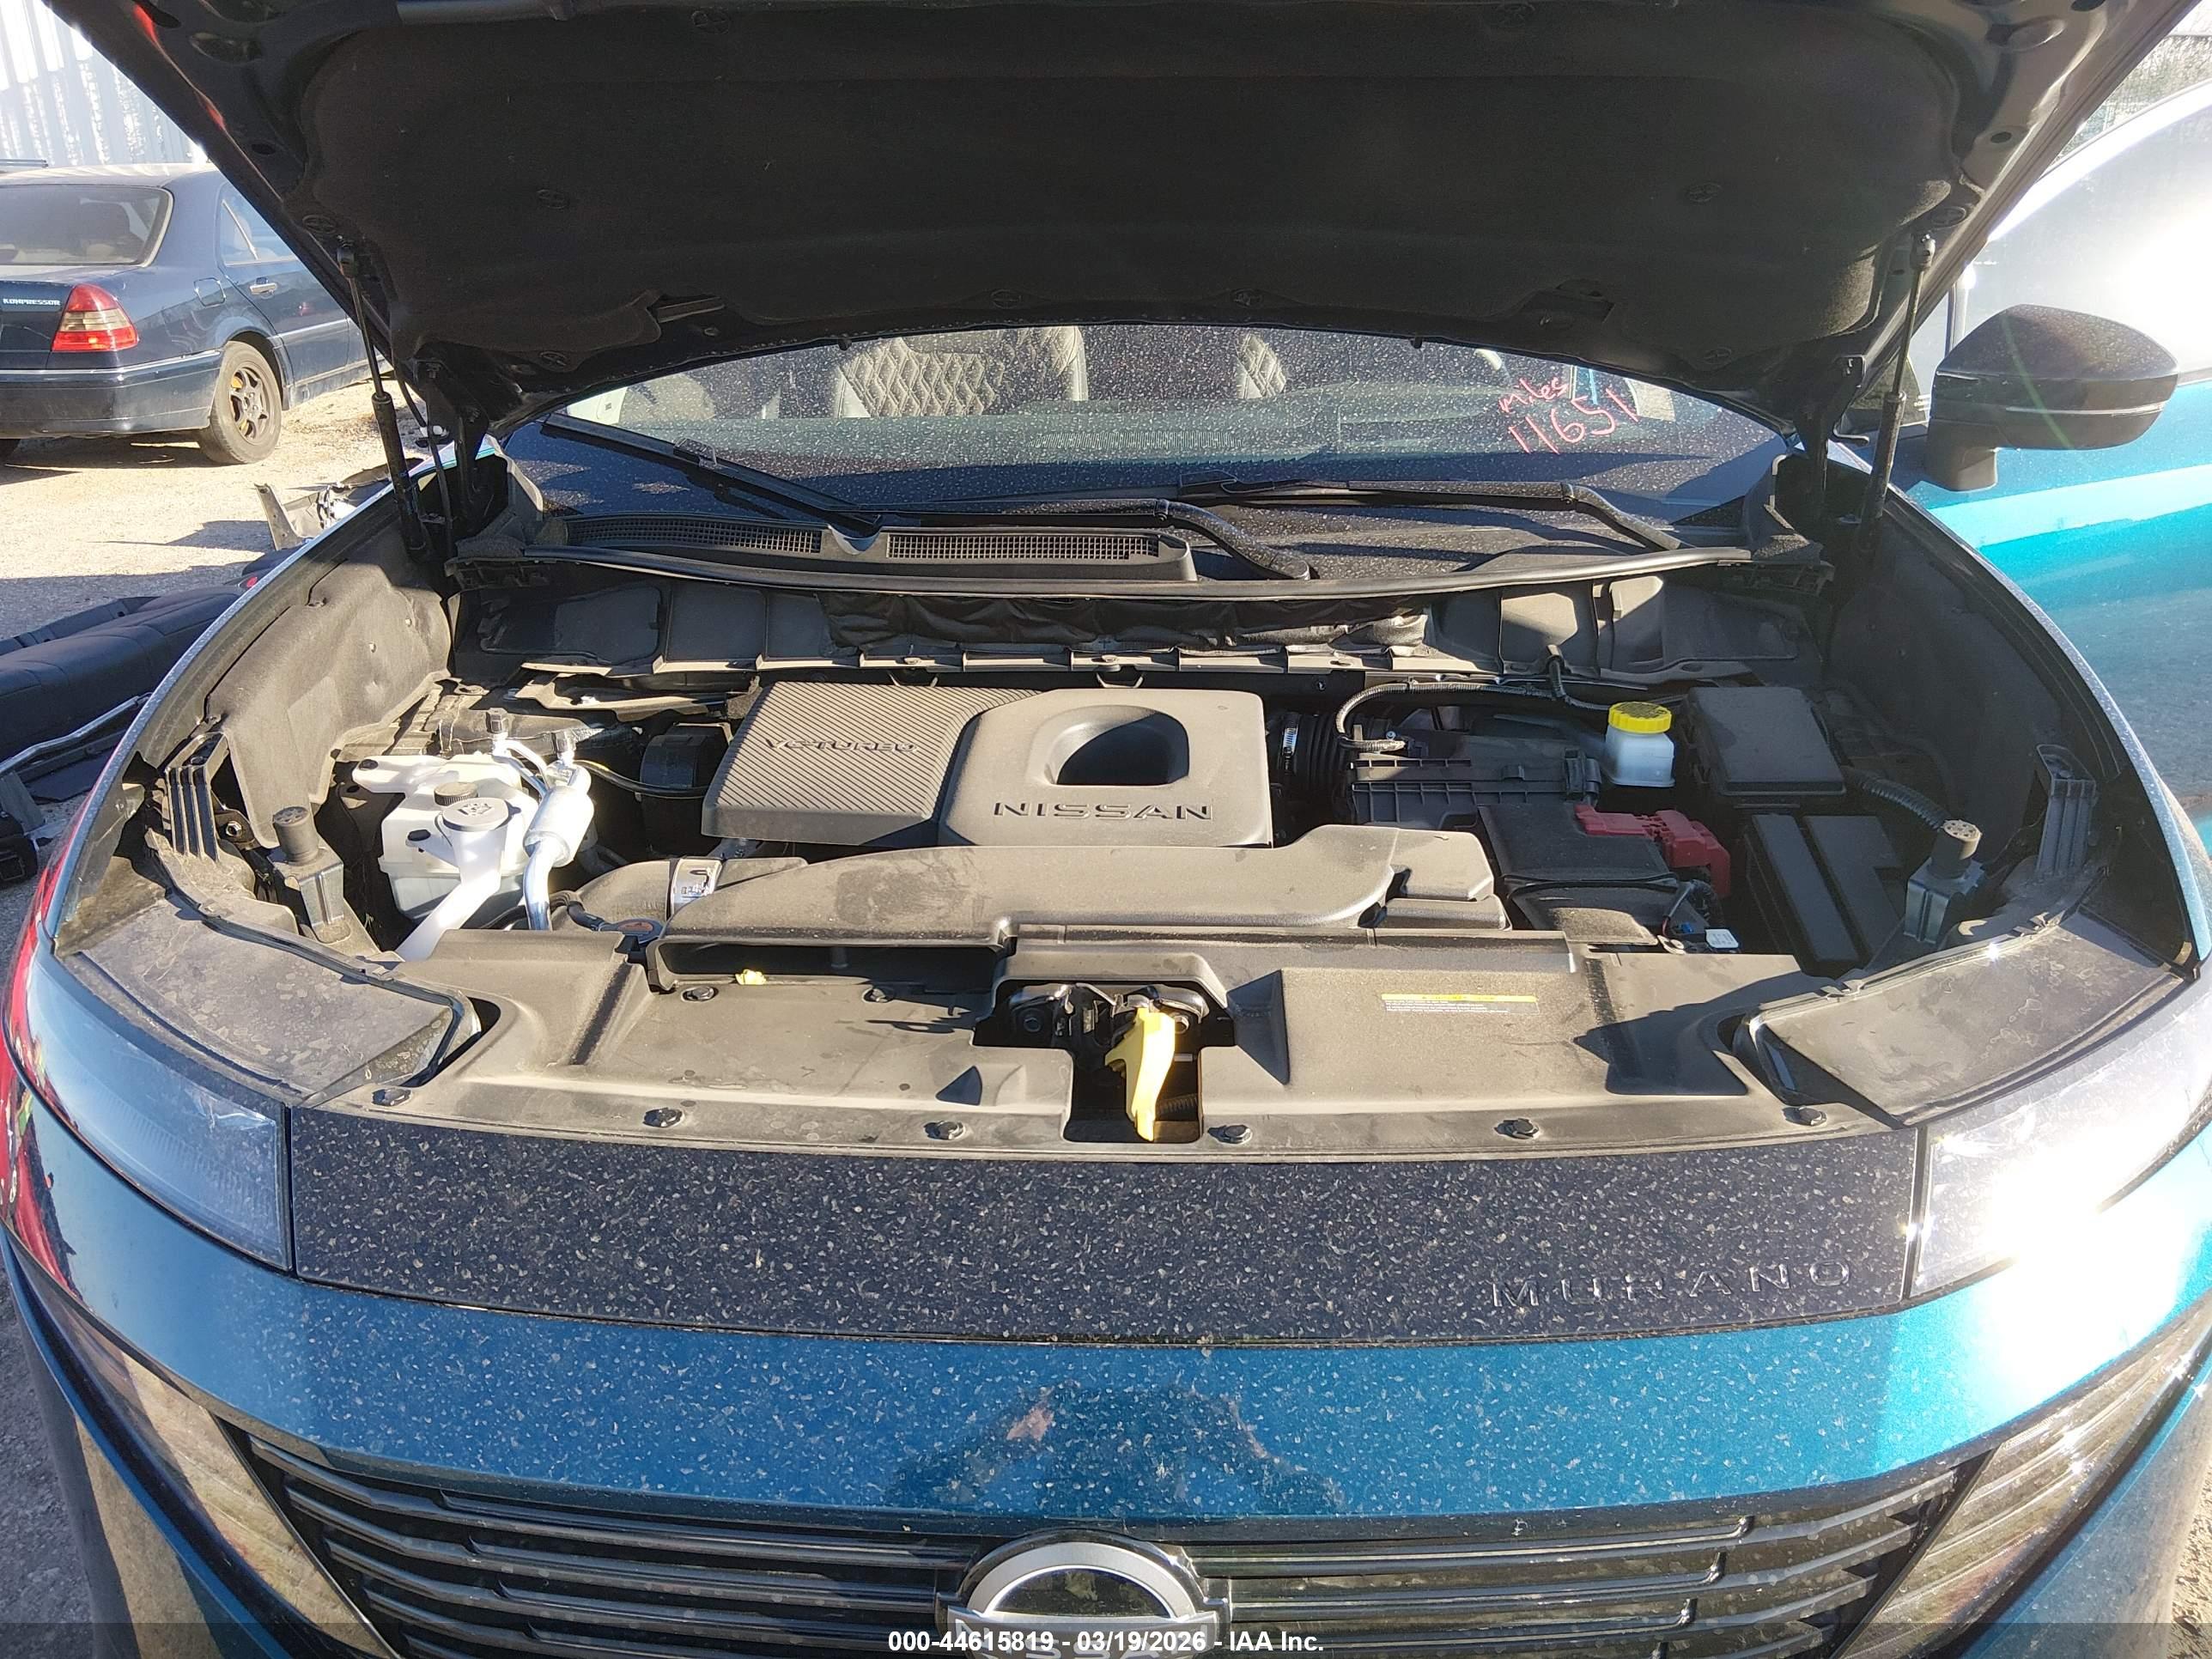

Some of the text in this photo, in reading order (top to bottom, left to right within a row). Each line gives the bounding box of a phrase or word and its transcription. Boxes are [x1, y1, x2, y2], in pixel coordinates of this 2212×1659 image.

[1509, 388, 1639, 455] 11651
[765, 738, 918, 753] VC-TURBO
[993, 801, 1213, 821] NISSAN
[1492, 1261, 1851, 1308] MURANO
